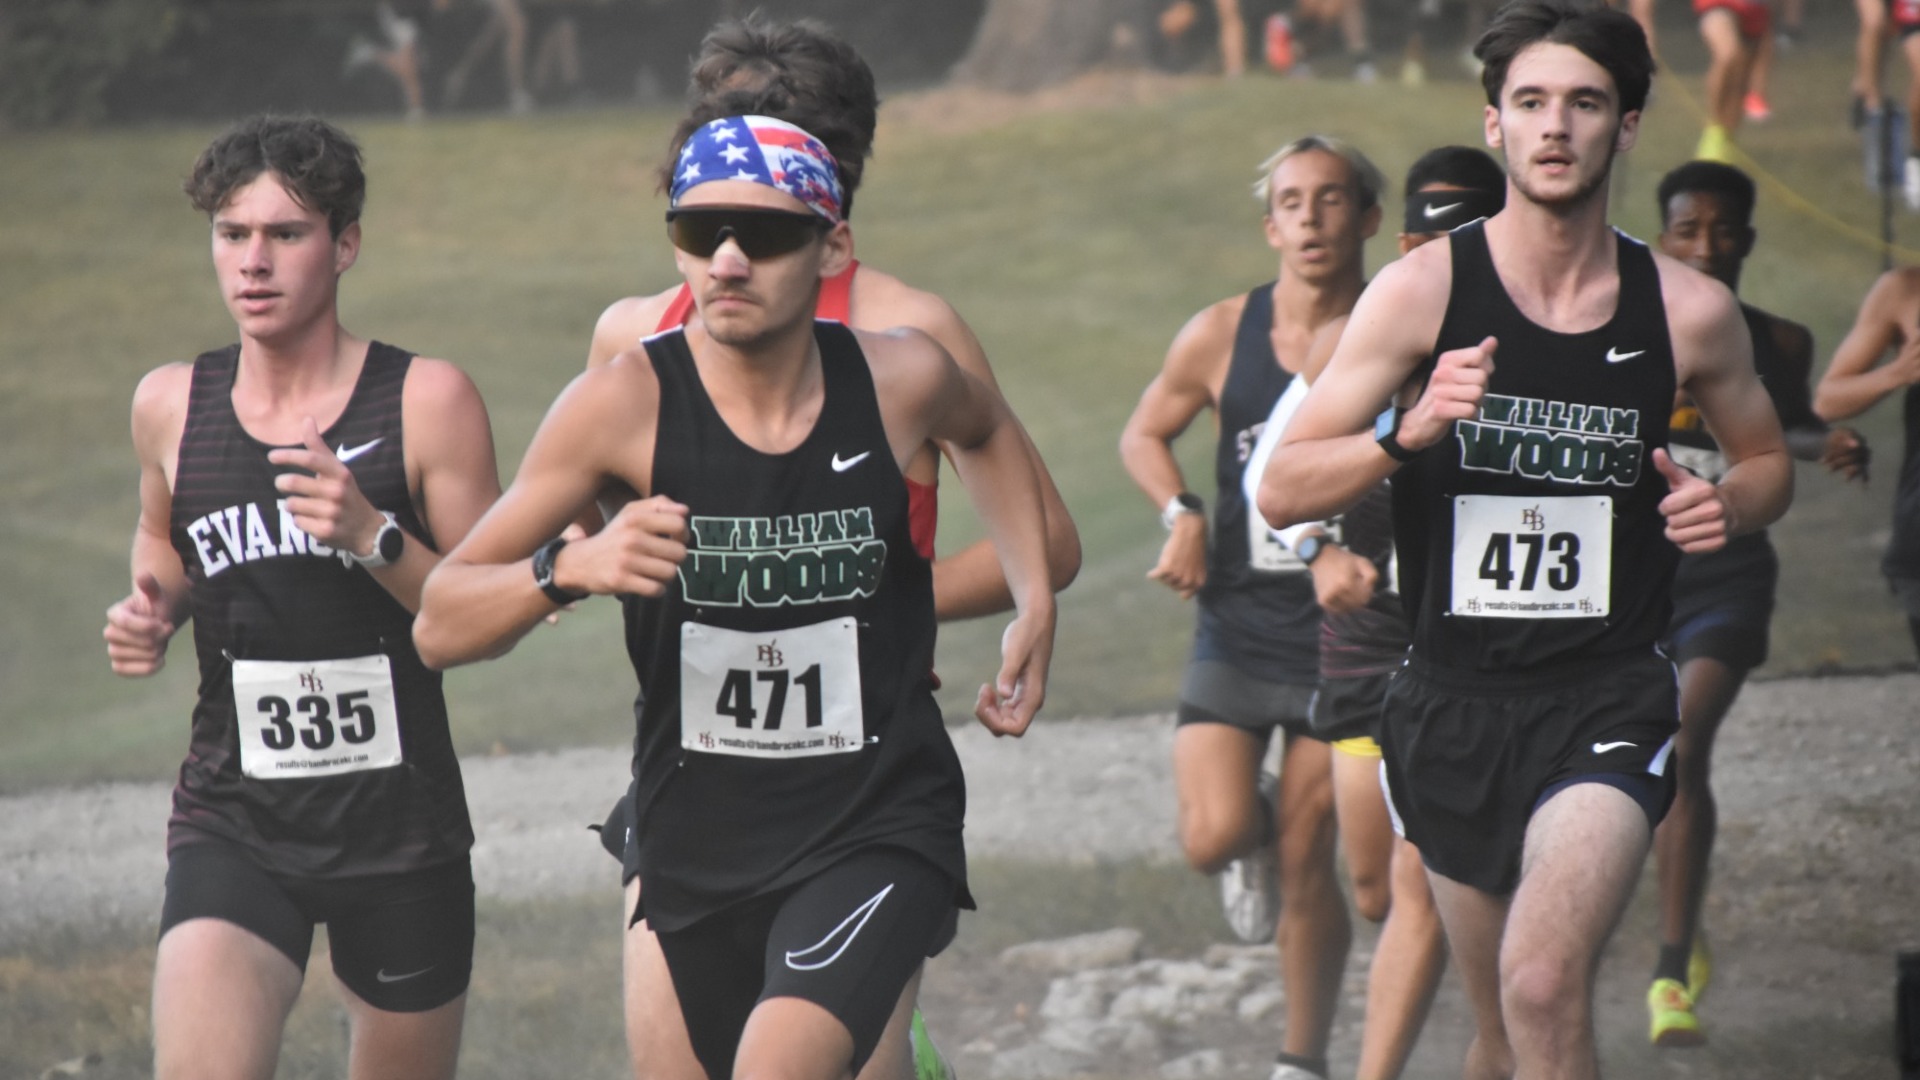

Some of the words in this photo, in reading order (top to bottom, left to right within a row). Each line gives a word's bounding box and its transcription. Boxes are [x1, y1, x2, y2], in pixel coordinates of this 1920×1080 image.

[1480, 393, 1639, 438] WILLIAM
[1456, 419, 1644, 486] WOODS
[187, 498, 346, 578] EVAN
[691, 507, 875, 550] WILLIAM
[677, 539, 887, 607] WOODS
[1478, 532, 1581, 591] 473
[257, 690, 376, 751] 335
[716, 664, 823, 730] 471
